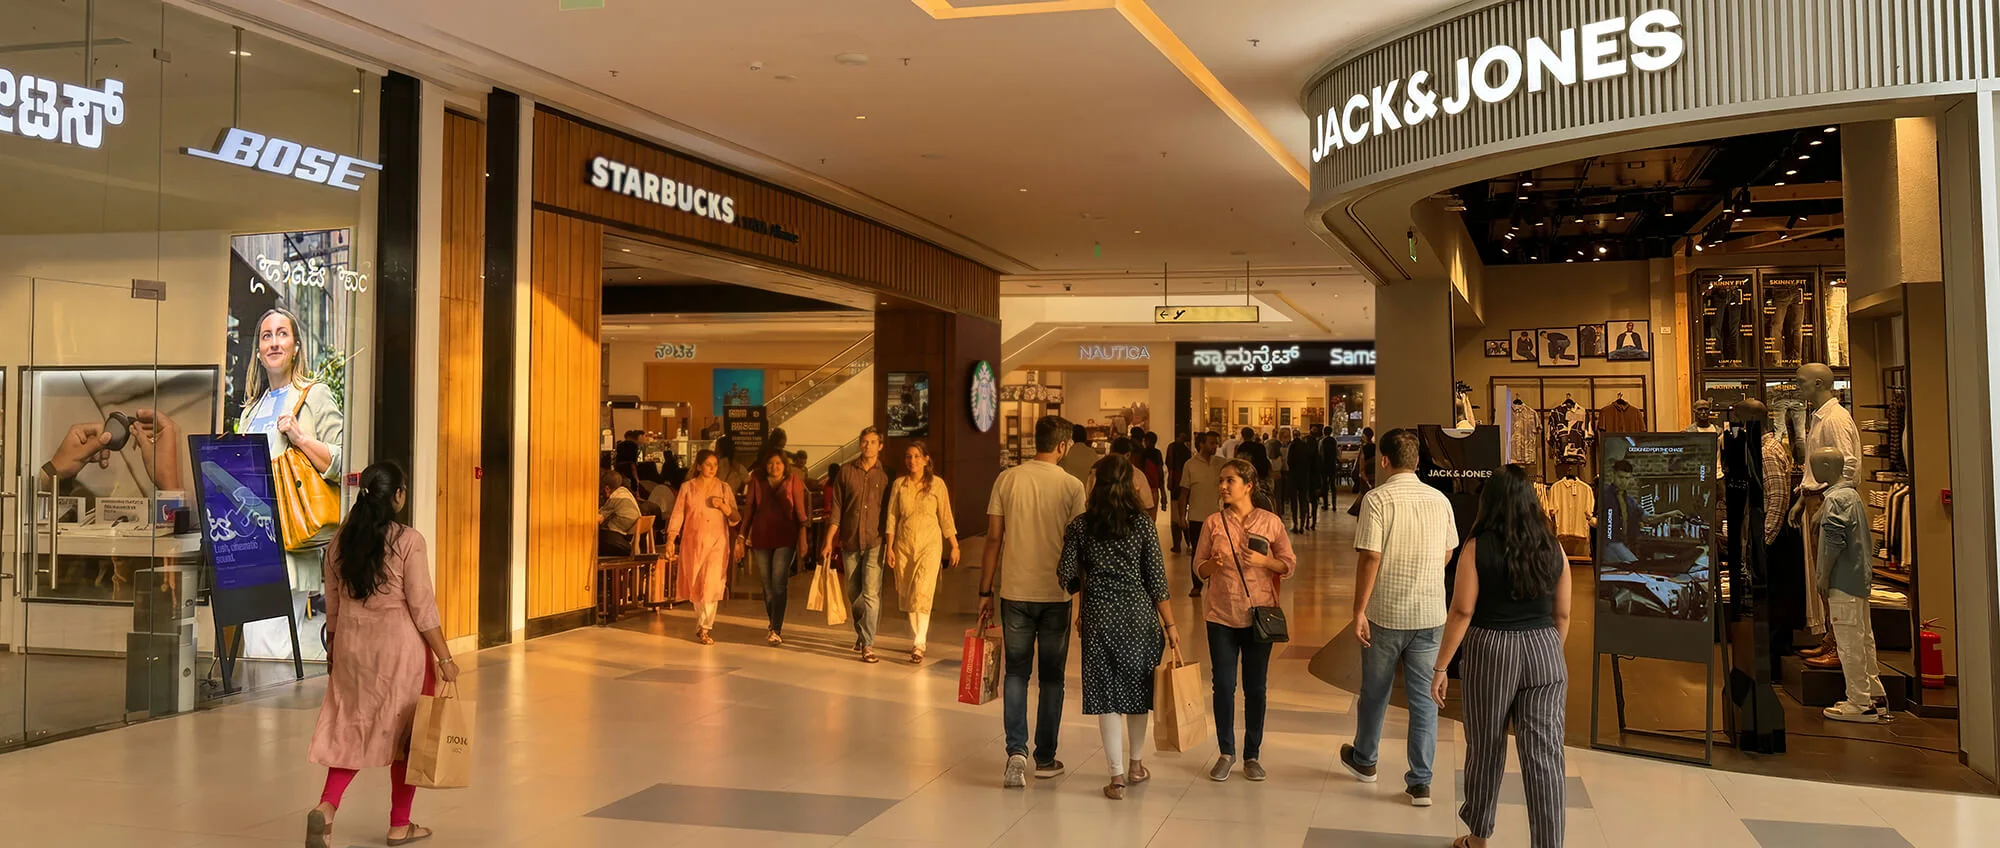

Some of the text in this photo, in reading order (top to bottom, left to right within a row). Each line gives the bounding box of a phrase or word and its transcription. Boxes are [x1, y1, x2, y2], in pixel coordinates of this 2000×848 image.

[186, 127, 383, 191] BOSE
[591, 156, 735, 224] STARBUCKS
[1080, 344, 1151, 360] NAUTICA
